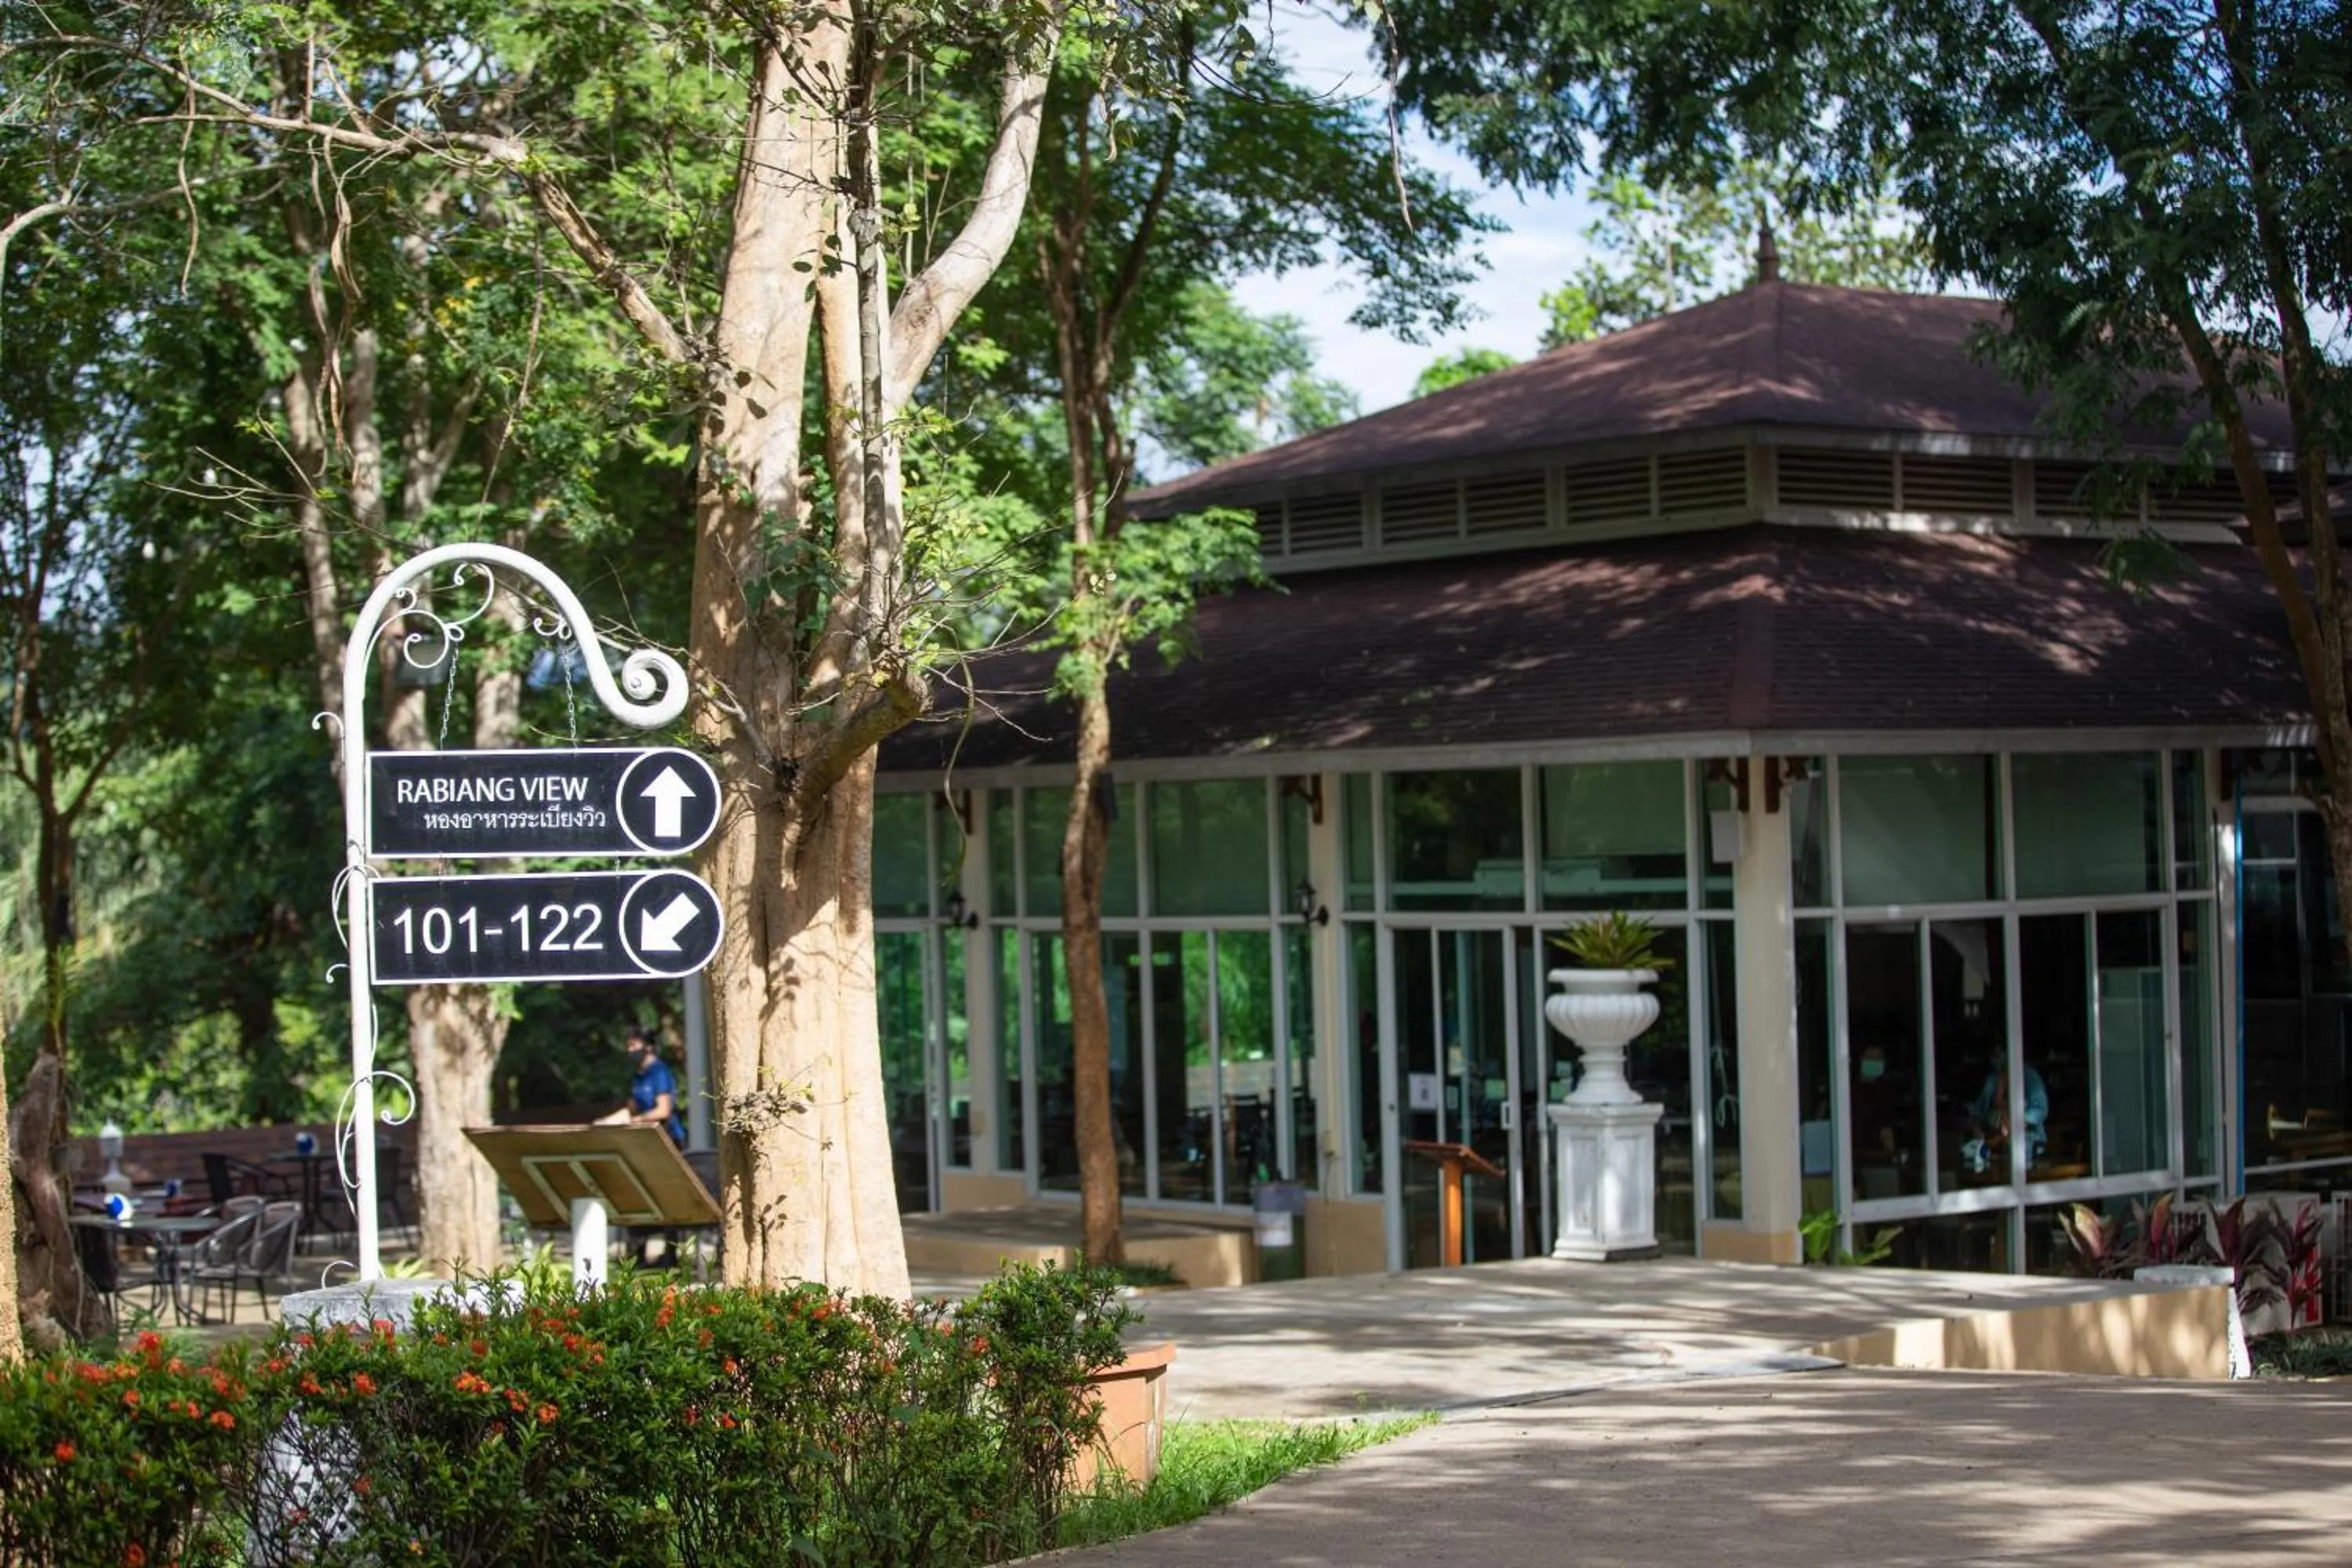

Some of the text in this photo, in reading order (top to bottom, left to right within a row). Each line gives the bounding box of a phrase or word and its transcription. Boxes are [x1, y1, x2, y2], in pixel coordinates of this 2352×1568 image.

[397, 775, 590, 804] RABIANG VIEW
[393, 902, 604, 955] 101-122
